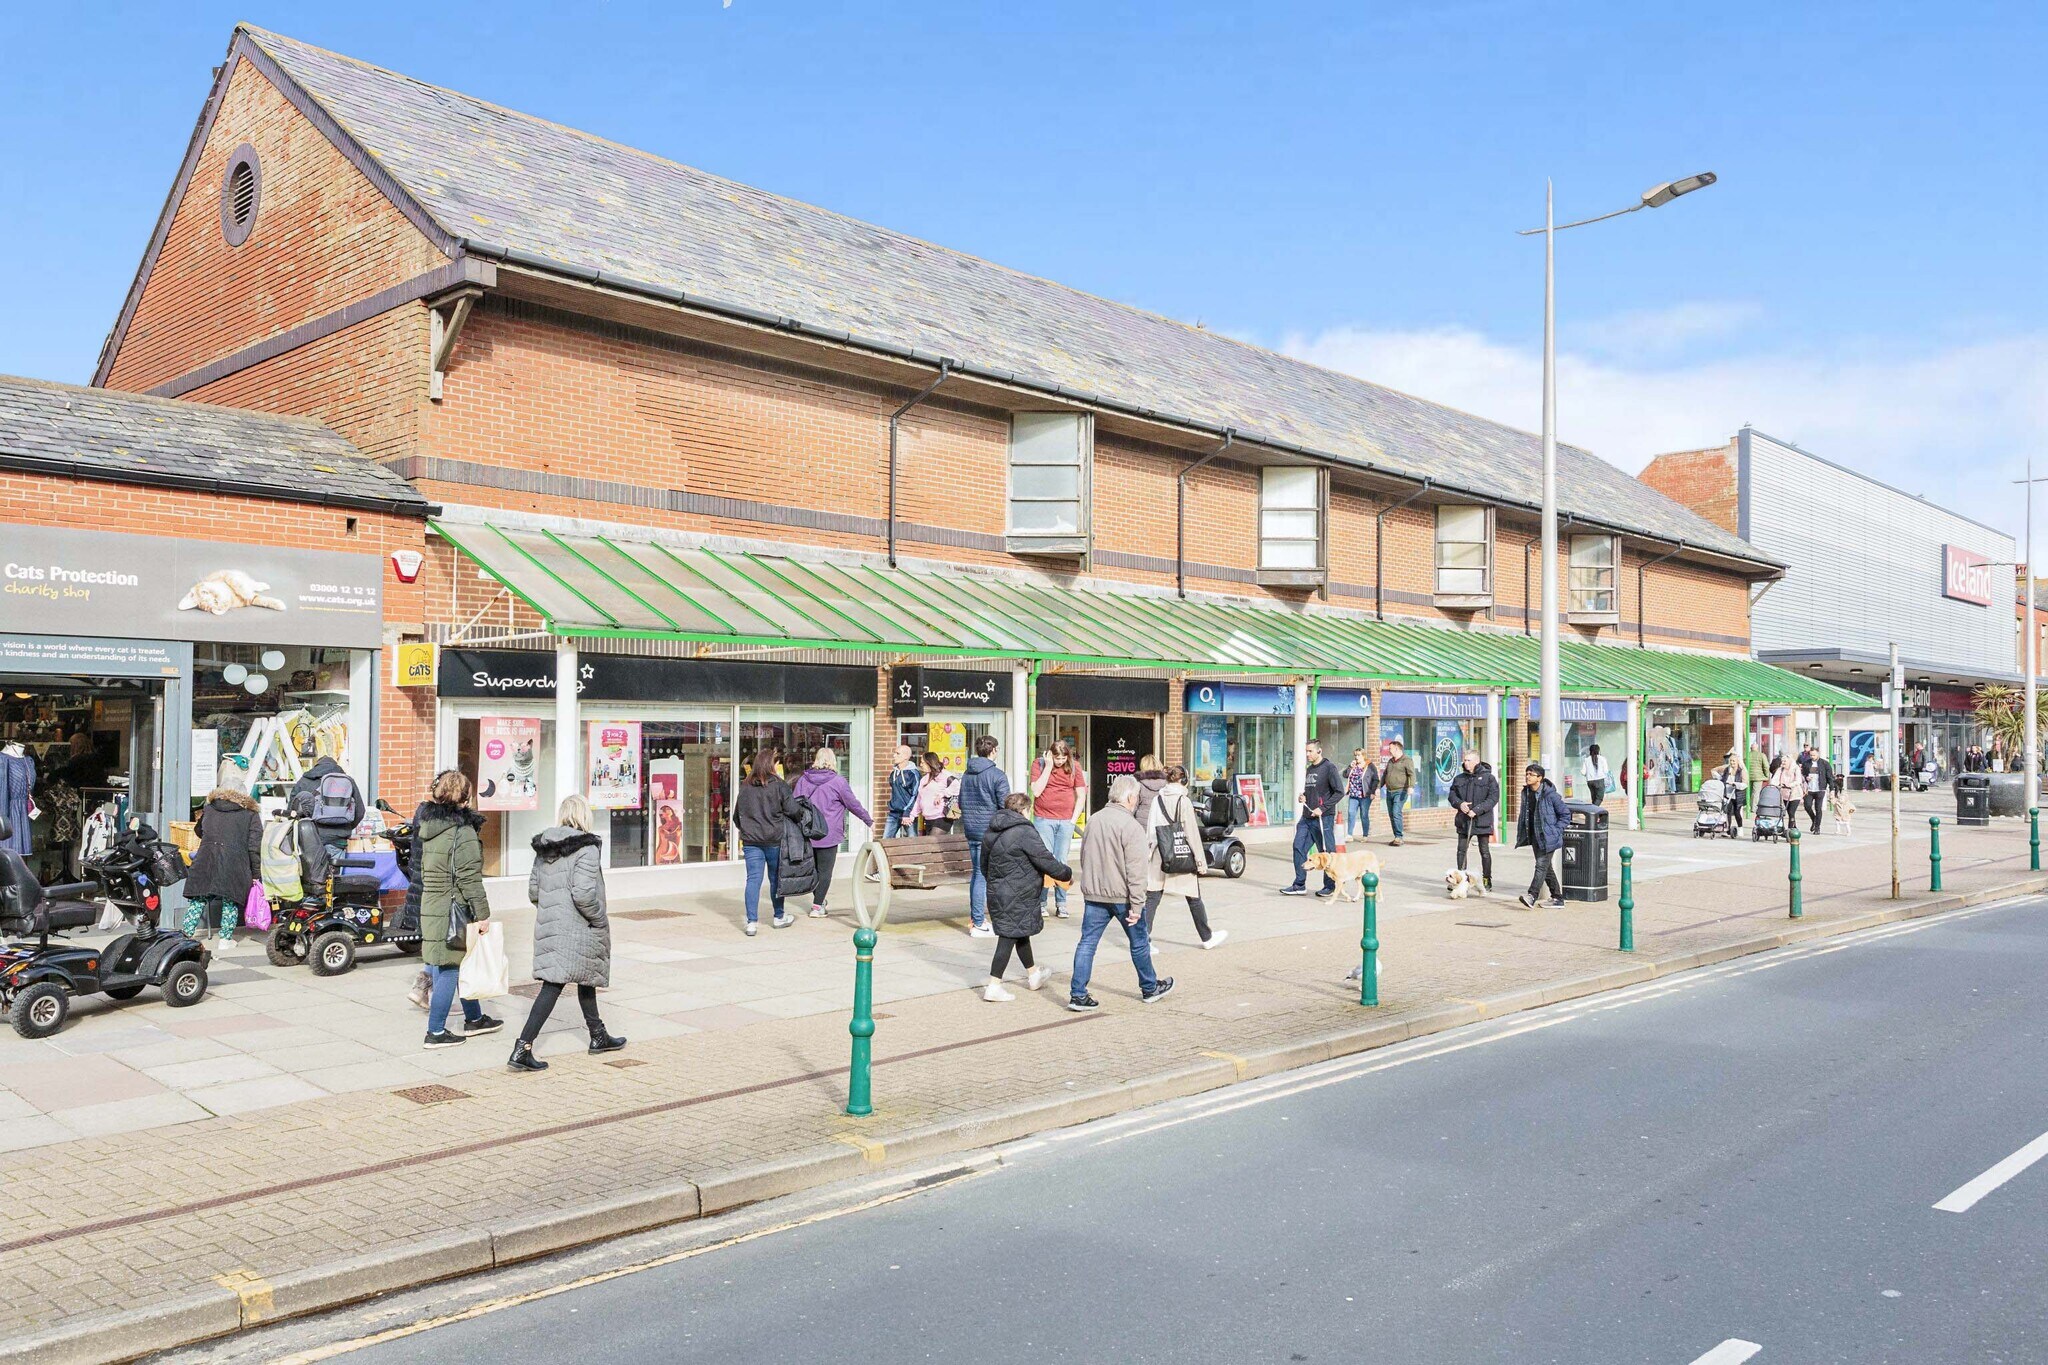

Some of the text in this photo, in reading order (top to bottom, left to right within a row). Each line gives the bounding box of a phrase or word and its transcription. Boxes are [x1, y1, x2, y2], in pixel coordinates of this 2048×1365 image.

[4, 563, 138, 586] Cats Protection
[1948, 551, 1991, 600] Iceland
[4, 580, 90, 601] charity shop
[310, 583, 376, 596] 03000 12 12 12
[299, 595, 376, 607] www.cats.org.uk
[3, 641, 26, 649] vision
[28, 642, 35, 650] is
[43, 643, 66, 651] world
[69, 643, 92, 652] where
[95, 645, 115, 655] every
[117, 646, 129, 654] cat
[130, 646, 137, 654] is
[138, 647, 165, 655] treated
[6, 649, 40, 658] kindness
[42, 650, 57, 659] and
[72, 652, 126, 663] understanding
[128, 654, 137, 662] of
[138, 654, 147, 662] its
[149, 655, 171, 663] needs
[408, 664, 431, 677] CATS
[923, 685, 990, 703] Superdrug
[1425, 695, 1483, 717] WHSmith
[1562, 700, 1606, 720] WHSmith
[1107, 761, 1136, 772] save
